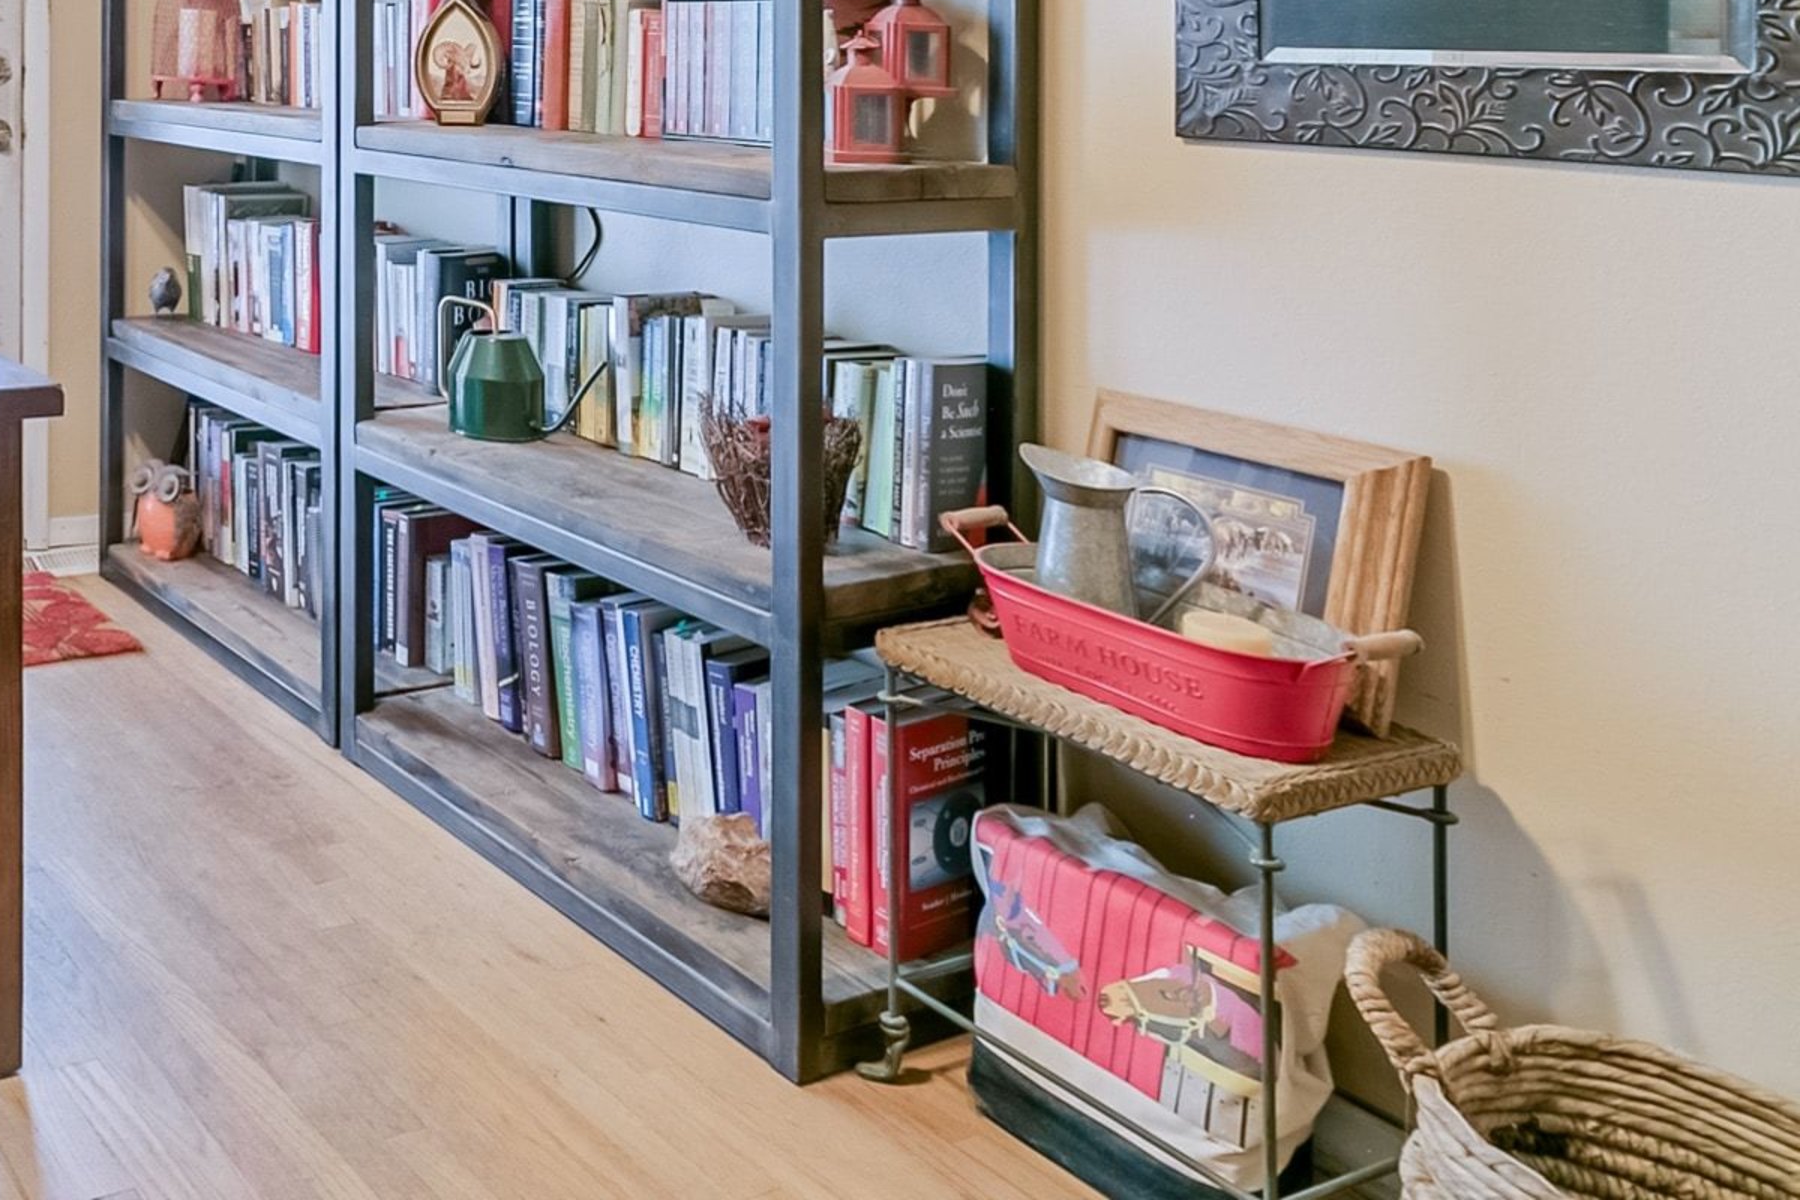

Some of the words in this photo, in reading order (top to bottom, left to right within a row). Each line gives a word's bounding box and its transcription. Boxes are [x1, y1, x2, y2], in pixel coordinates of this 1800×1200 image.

[526, 599, 541, 696] BIOLOGY
[560, 627, 576, 739] Biochemistry
[630, 645, 644, 719] CHEMISTRY
[1013, 615, 1088, 657] FARM
[1099, 646, 1203, 699] HOUSE
[909, 735, 967, 762] Separation
